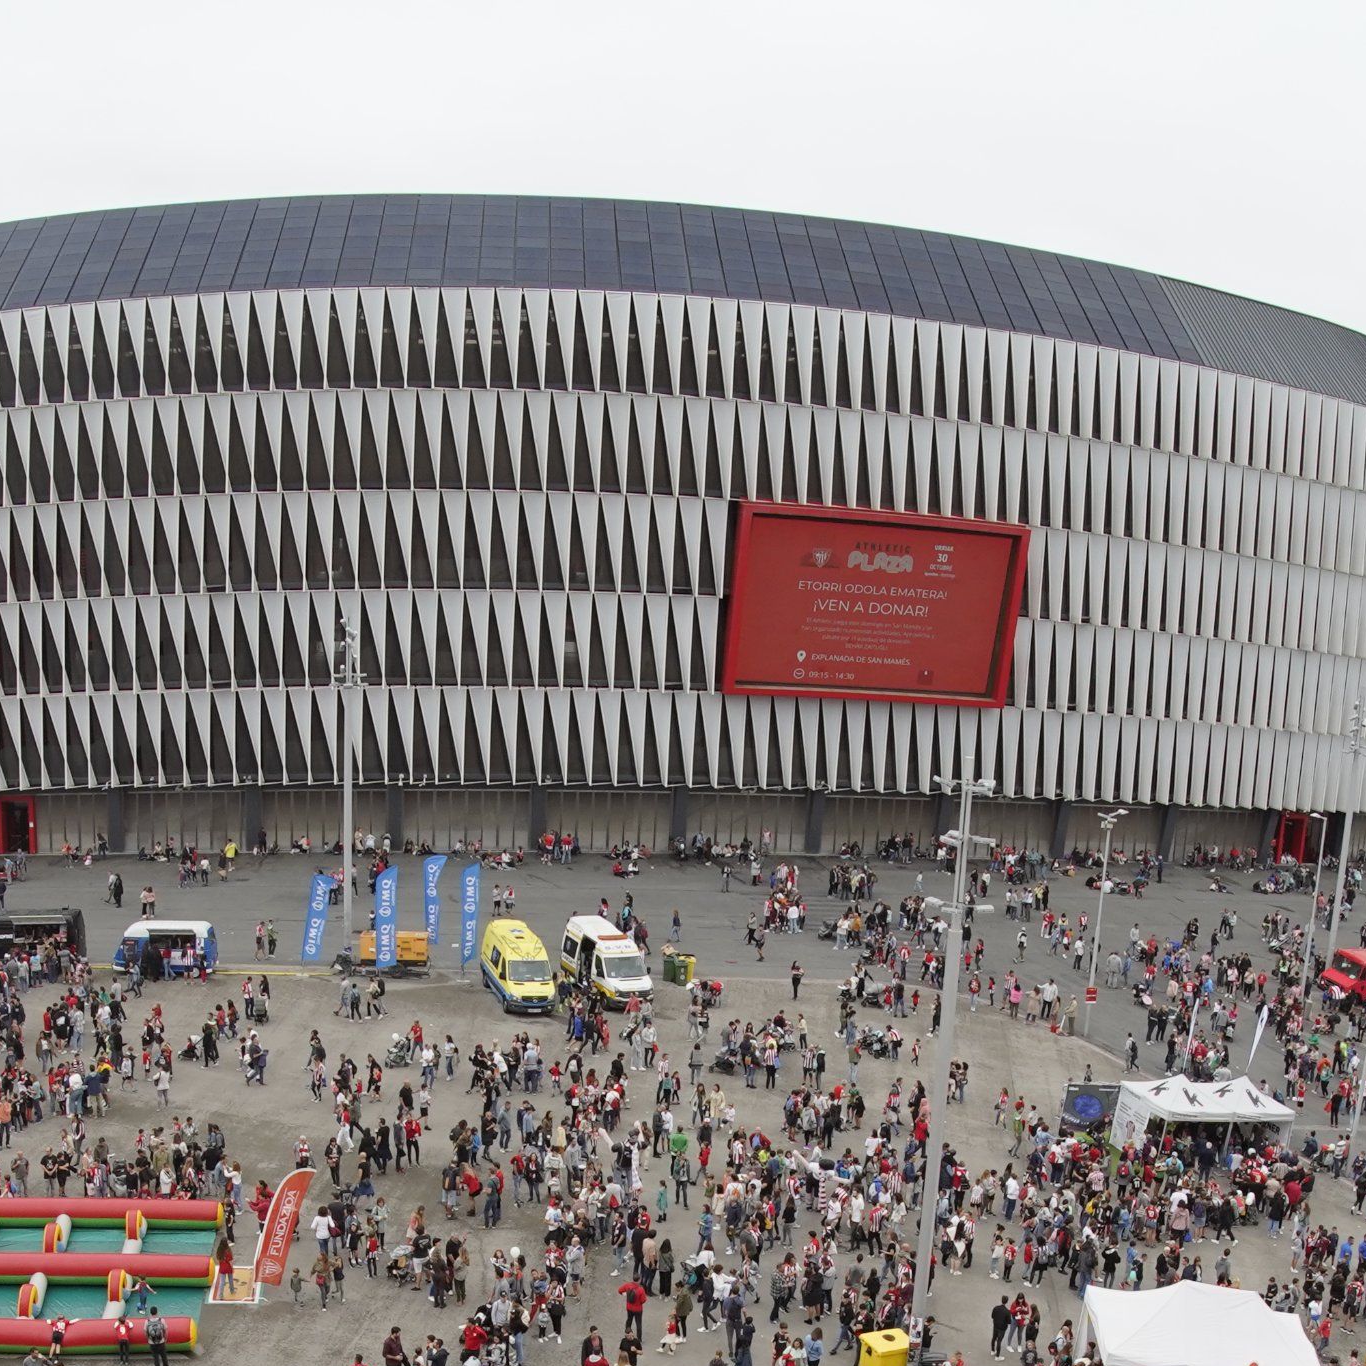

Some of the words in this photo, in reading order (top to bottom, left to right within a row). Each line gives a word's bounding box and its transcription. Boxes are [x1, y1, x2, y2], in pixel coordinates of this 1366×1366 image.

[854, 541, 912, 554] ATHLETIC
[847, 551, 914, 573] PLAZA
[937, 553, 948, 563] 30
[798, 580, 842, 592] ETORRI
[844, 584, 887, 595] ODOLA
[890, 586, 948, 599] EMATERA!
[813, 598, 850, 612] ¡VEN
[853, 601, 864, 613] A
[868, 602, 929, 617] DONAR!
[811, 653, 855, 663] EXPLANADA
[867, 656, 883, 665] SAN
[808, 671, 829, 680] 09:15
[835, 672, 855, 680] 14:30
[382, 879, 392, 905] IMQ
[466, 877, 475, 902] IMQ
[309, 918, 322, 944] IMQ
[381, 924, 391, 950] IMQ
[270, 1190, 297, 1256] FUNDAZIOA
